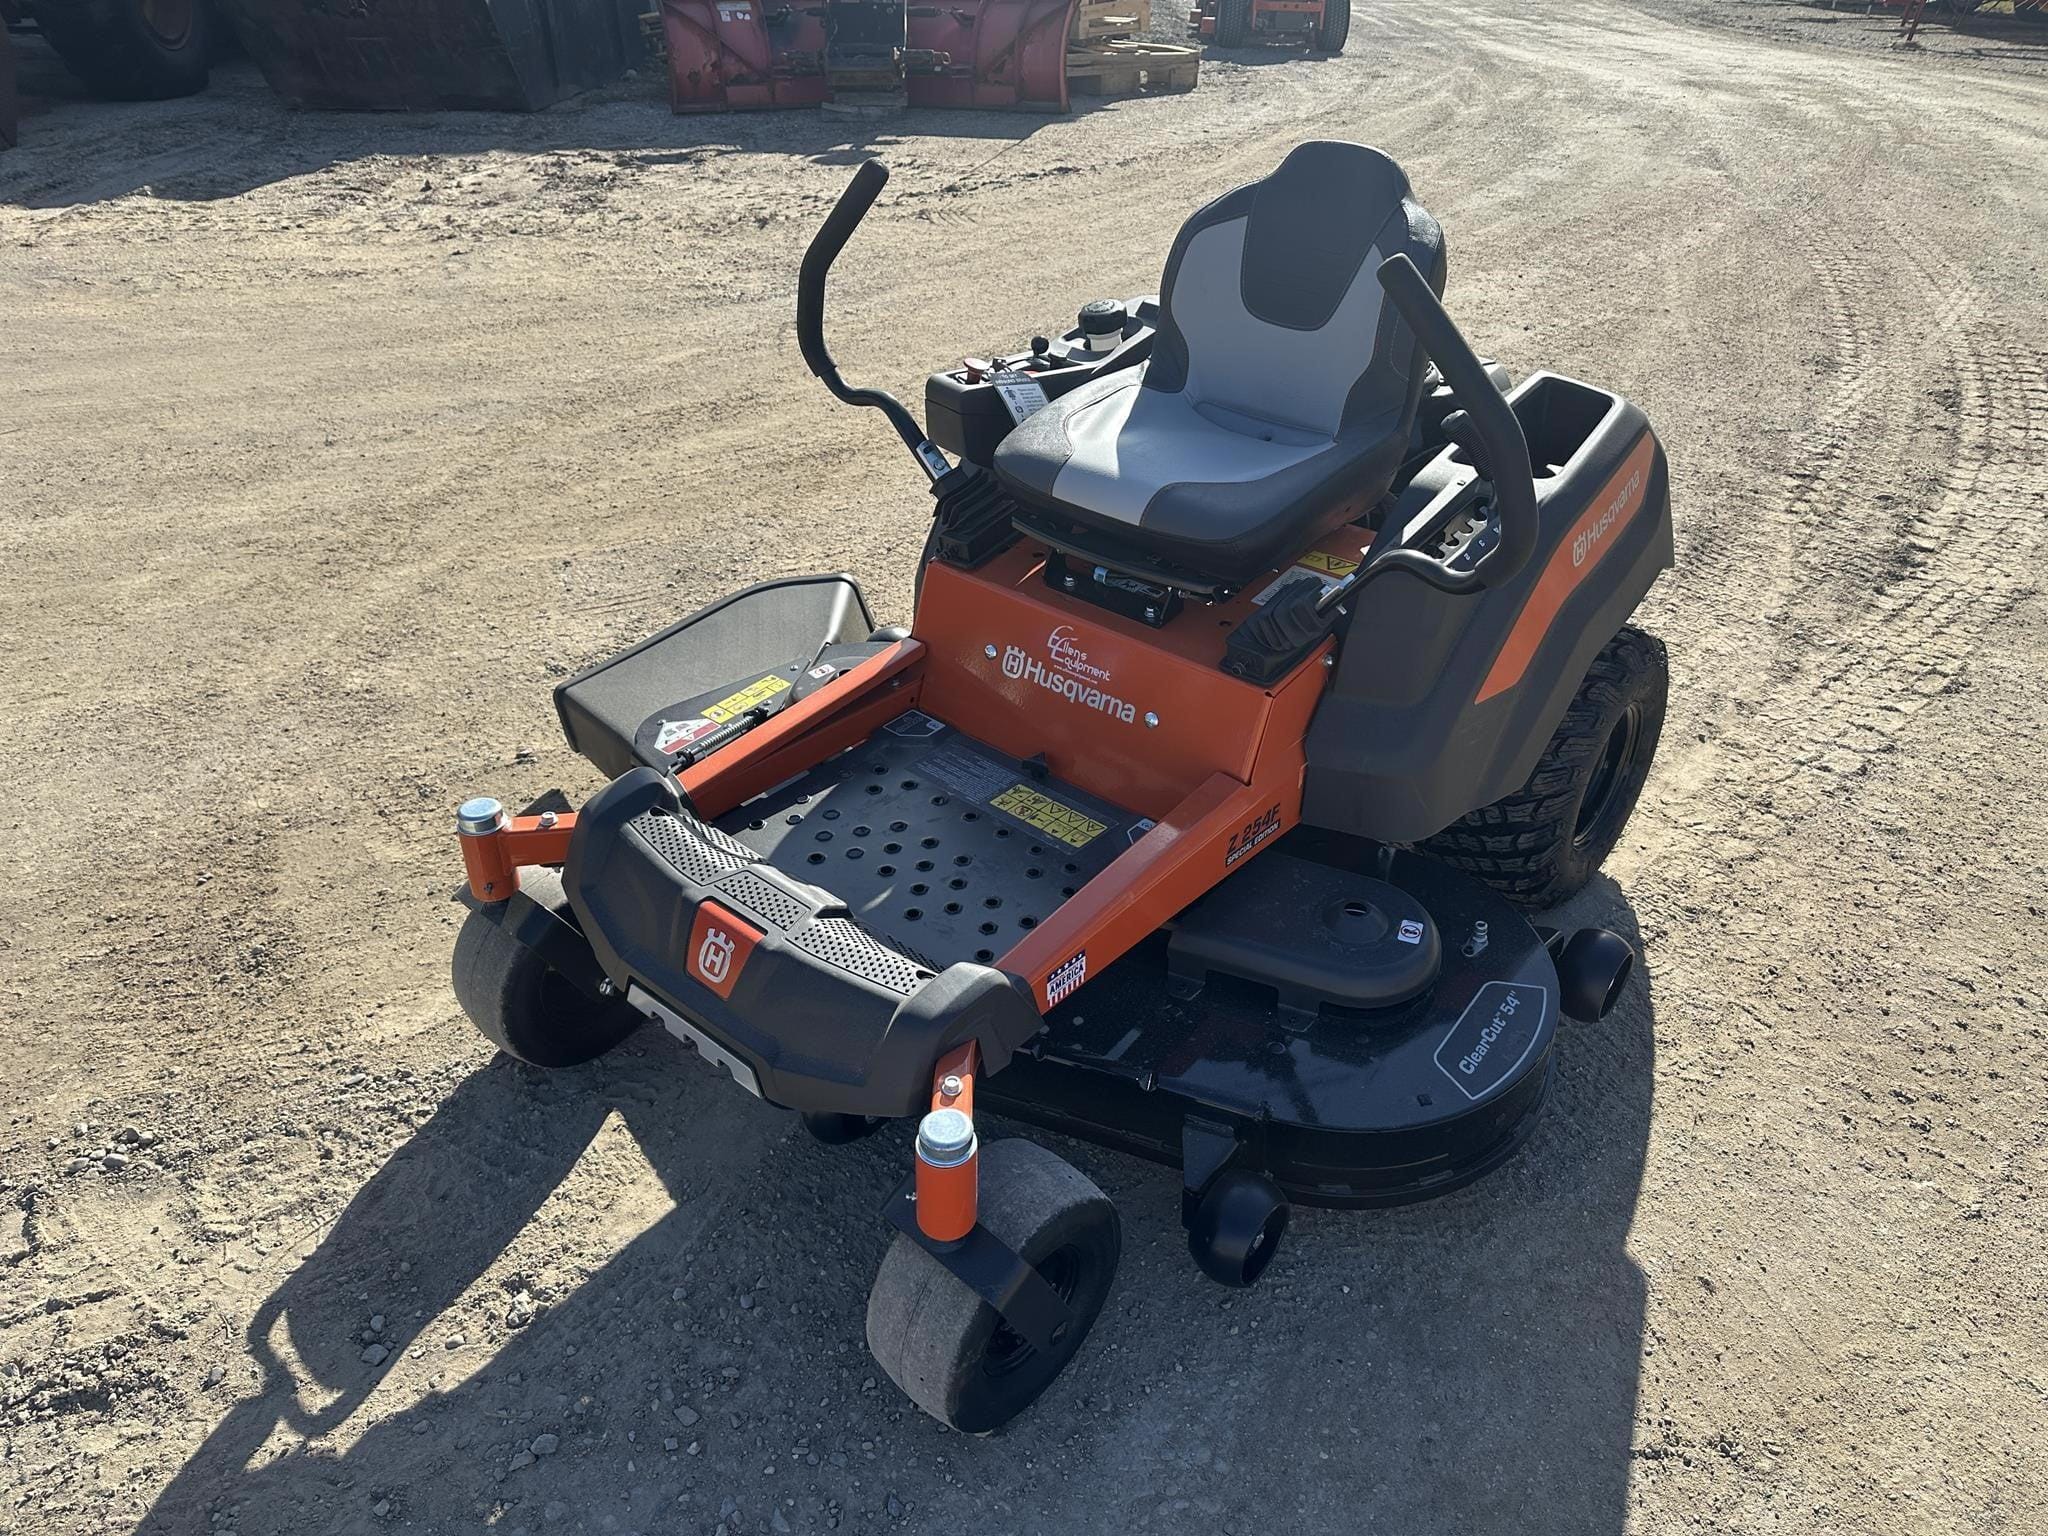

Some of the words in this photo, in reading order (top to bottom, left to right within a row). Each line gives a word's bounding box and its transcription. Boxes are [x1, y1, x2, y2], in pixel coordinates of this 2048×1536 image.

[1587, 469, 1640, 551] Husqvarna
[1463, 552, 1471, 561] 2
[1478, 539, 1486, 547] 3
[1047, 625, 1088, 661] Ellens
[1050, 637, 1111, 681] Equipment
[1023, 657, 1137, 724] Husqvarna
[1227, 832, 1240, 855] Z
[1242, 802, 1281, 844] 254F
[1227, 841, 1253, 865] SPECIAL
[1254, 821, 1280, 845] EDITION
[1049, 961, 1085, 996] AMERICA
[1500, 990, 1521, 1016] 54"
